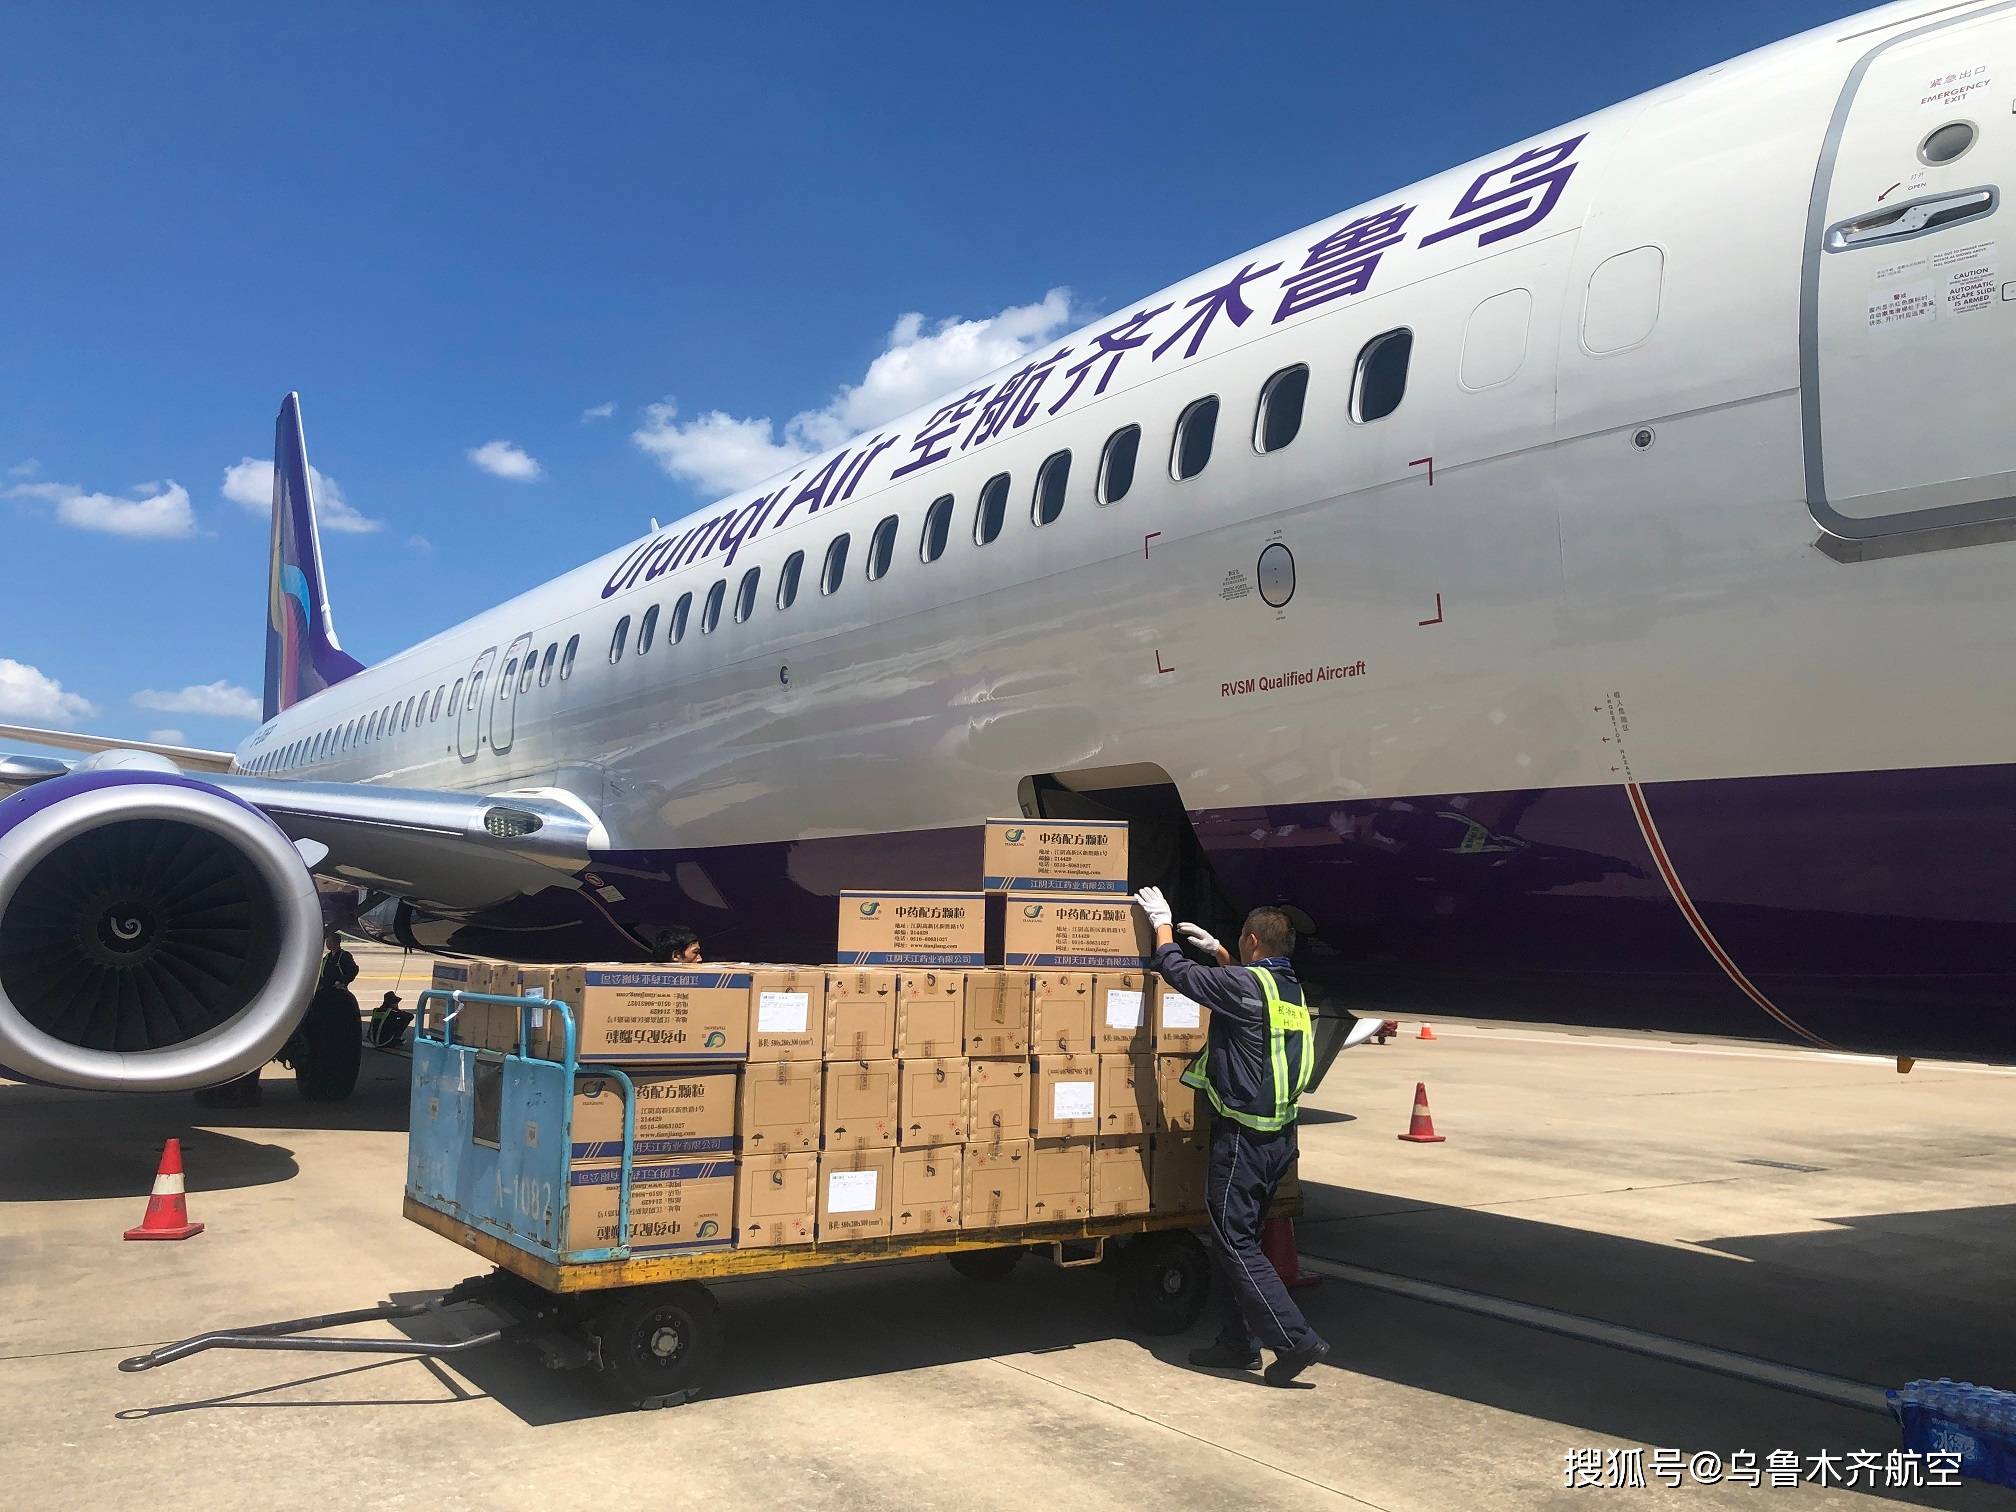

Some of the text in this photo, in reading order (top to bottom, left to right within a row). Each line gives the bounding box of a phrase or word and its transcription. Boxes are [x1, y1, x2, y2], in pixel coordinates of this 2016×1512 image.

[1920, 78, 1992, 105] EMERGENCY
[1944, 93, 1968, 105] EXIT
[1907, 181, 1927, 191] OPEN
[1953, 267, 1989, 280] CAUTION
[1947, 286, 1996, 302] ESCAPE SLIDE
[1949, 280, 1994, 295] AUTOMATIC
[1954, 299, 1961, 307] IS
[1963, 294, 1990, 306] ARMED
[601, 432, 902, 599] Urumqi Air
[1221, 660, 1366, 697] RVSM Qualified Aircraft
[1039, 833, 1108, 846] 中药配方颗粒
[1030, 879, 1115, 890] 江阴天江药业有限公司
[895, 906, 965, 919] 中药配方颗粒
[1056, 908, 1126, 922] 中药配方颗粒
[885, 954, 971, 964] 江阴天江药业有限公司
[1053, 956, 1140, 967] 江阴天江药业有限公司
[600, 974, 699, 985] 江阴天江药业有限公司
[605, 1029, 687, 1044] 中药配方颗粒
[634, 1084, 705, 1099] 药配方颗粒
[634, 1139, 721, 1153] 阴天江药业有限公司
